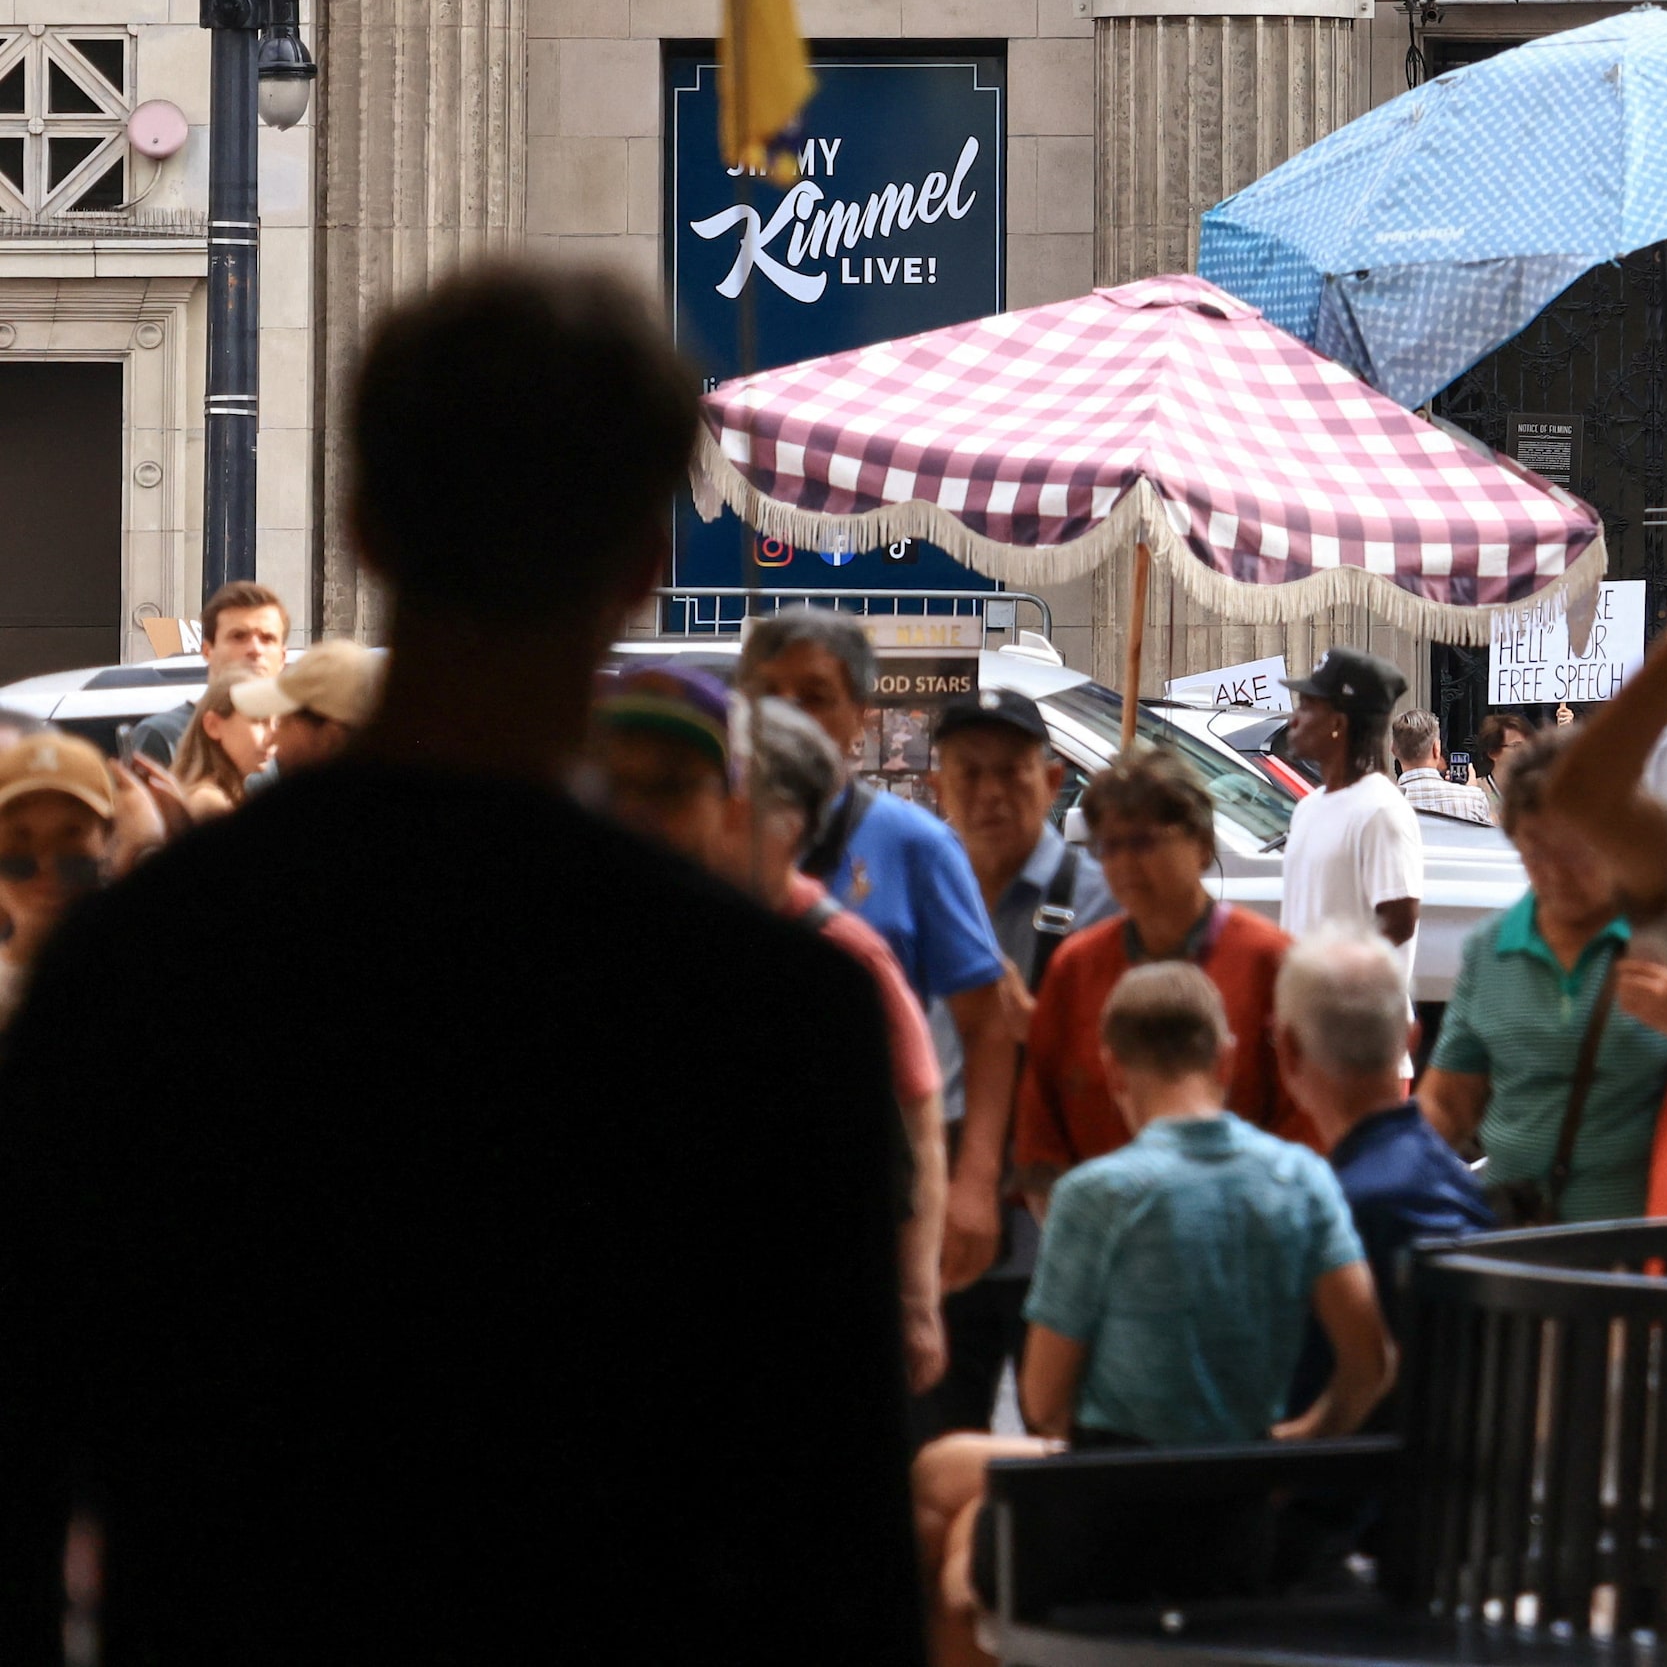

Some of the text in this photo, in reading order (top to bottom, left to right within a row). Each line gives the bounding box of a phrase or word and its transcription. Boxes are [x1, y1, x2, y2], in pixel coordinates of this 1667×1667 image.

[690, 136, 979, 303] Kimmel
[841, 257, 938, 284] LIVE!
[1517, 424, 1573, 434] NOTICE OF FILMING
[915, 676, 971, 693] STARS
[1498, 662, 1625, 702] FREE SPEECH
